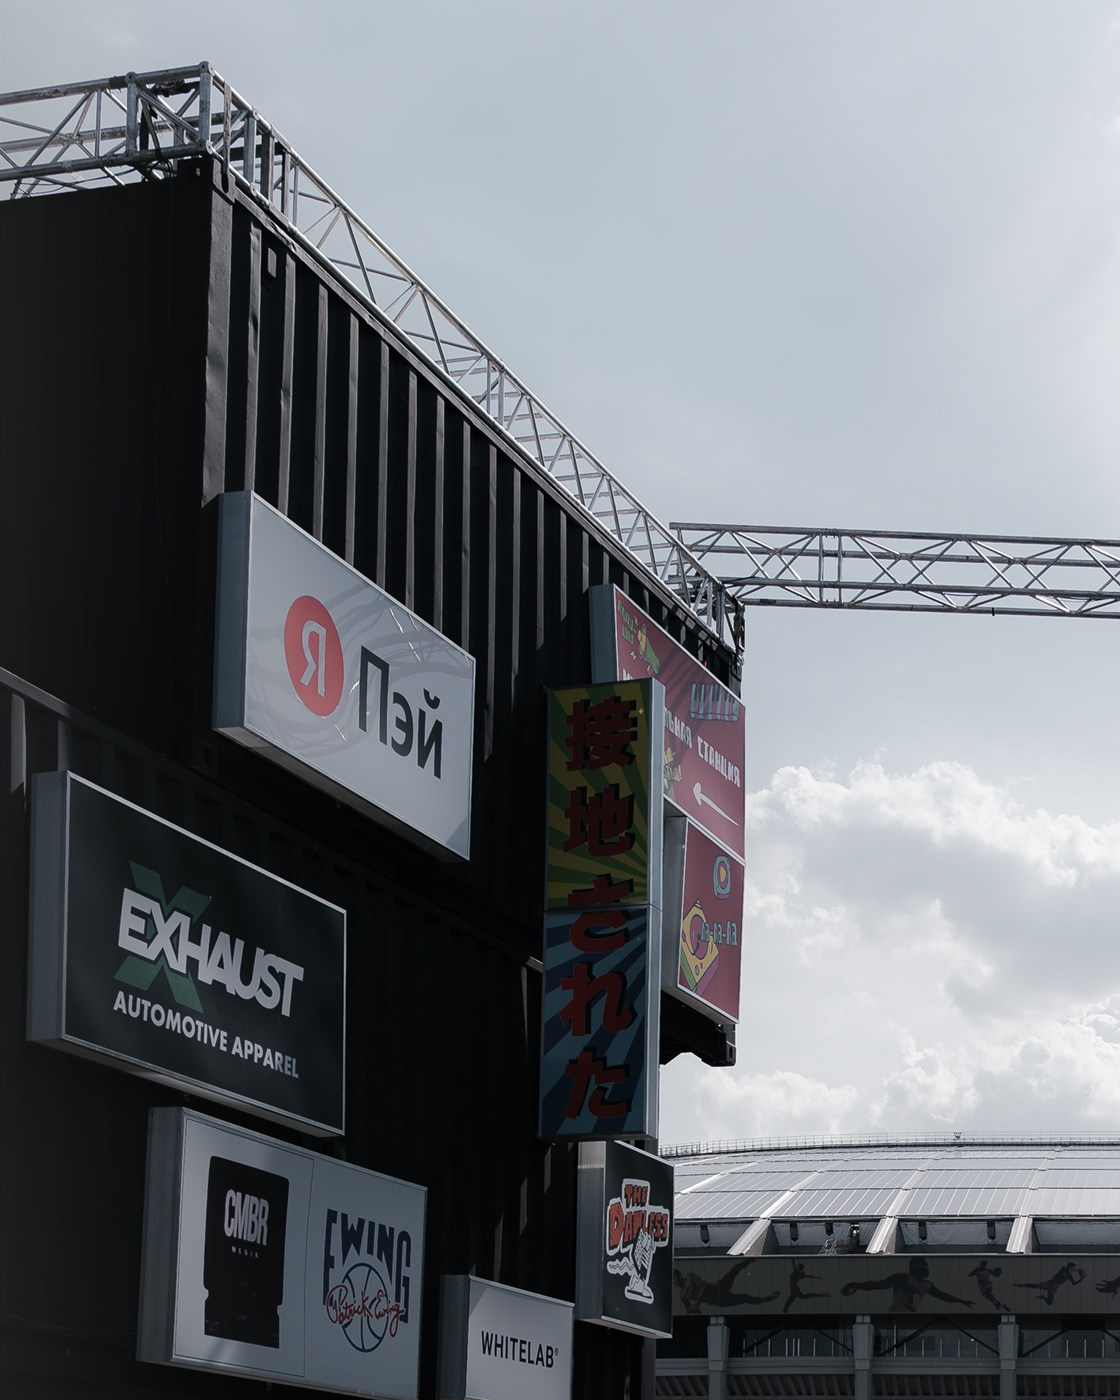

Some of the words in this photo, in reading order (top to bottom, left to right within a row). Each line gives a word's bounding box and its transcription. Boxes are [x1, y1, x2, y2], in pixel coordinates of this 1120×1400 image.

[300, 619, 327, 698] Я
[358, 645, 443, 780] Пэй
[697, 735, 741, 788] СТАНЦИЯ
[118, 887, 305, 1018] EXHAUST
[560, 696, 637, 1120] 接地された
[113, 990, 229, 1052] AUTOMOTIVE
[231, 1036, 300, 1079] APPAREL
[223, 1188, 270, 1246] CMBR
[624, 1184, 649, 1207] THE
[323, 1208, 412, 1324] EWING
[326, 1284, 373, 1326] Patrick
[374, 1289, 406, 1338] Ewing
